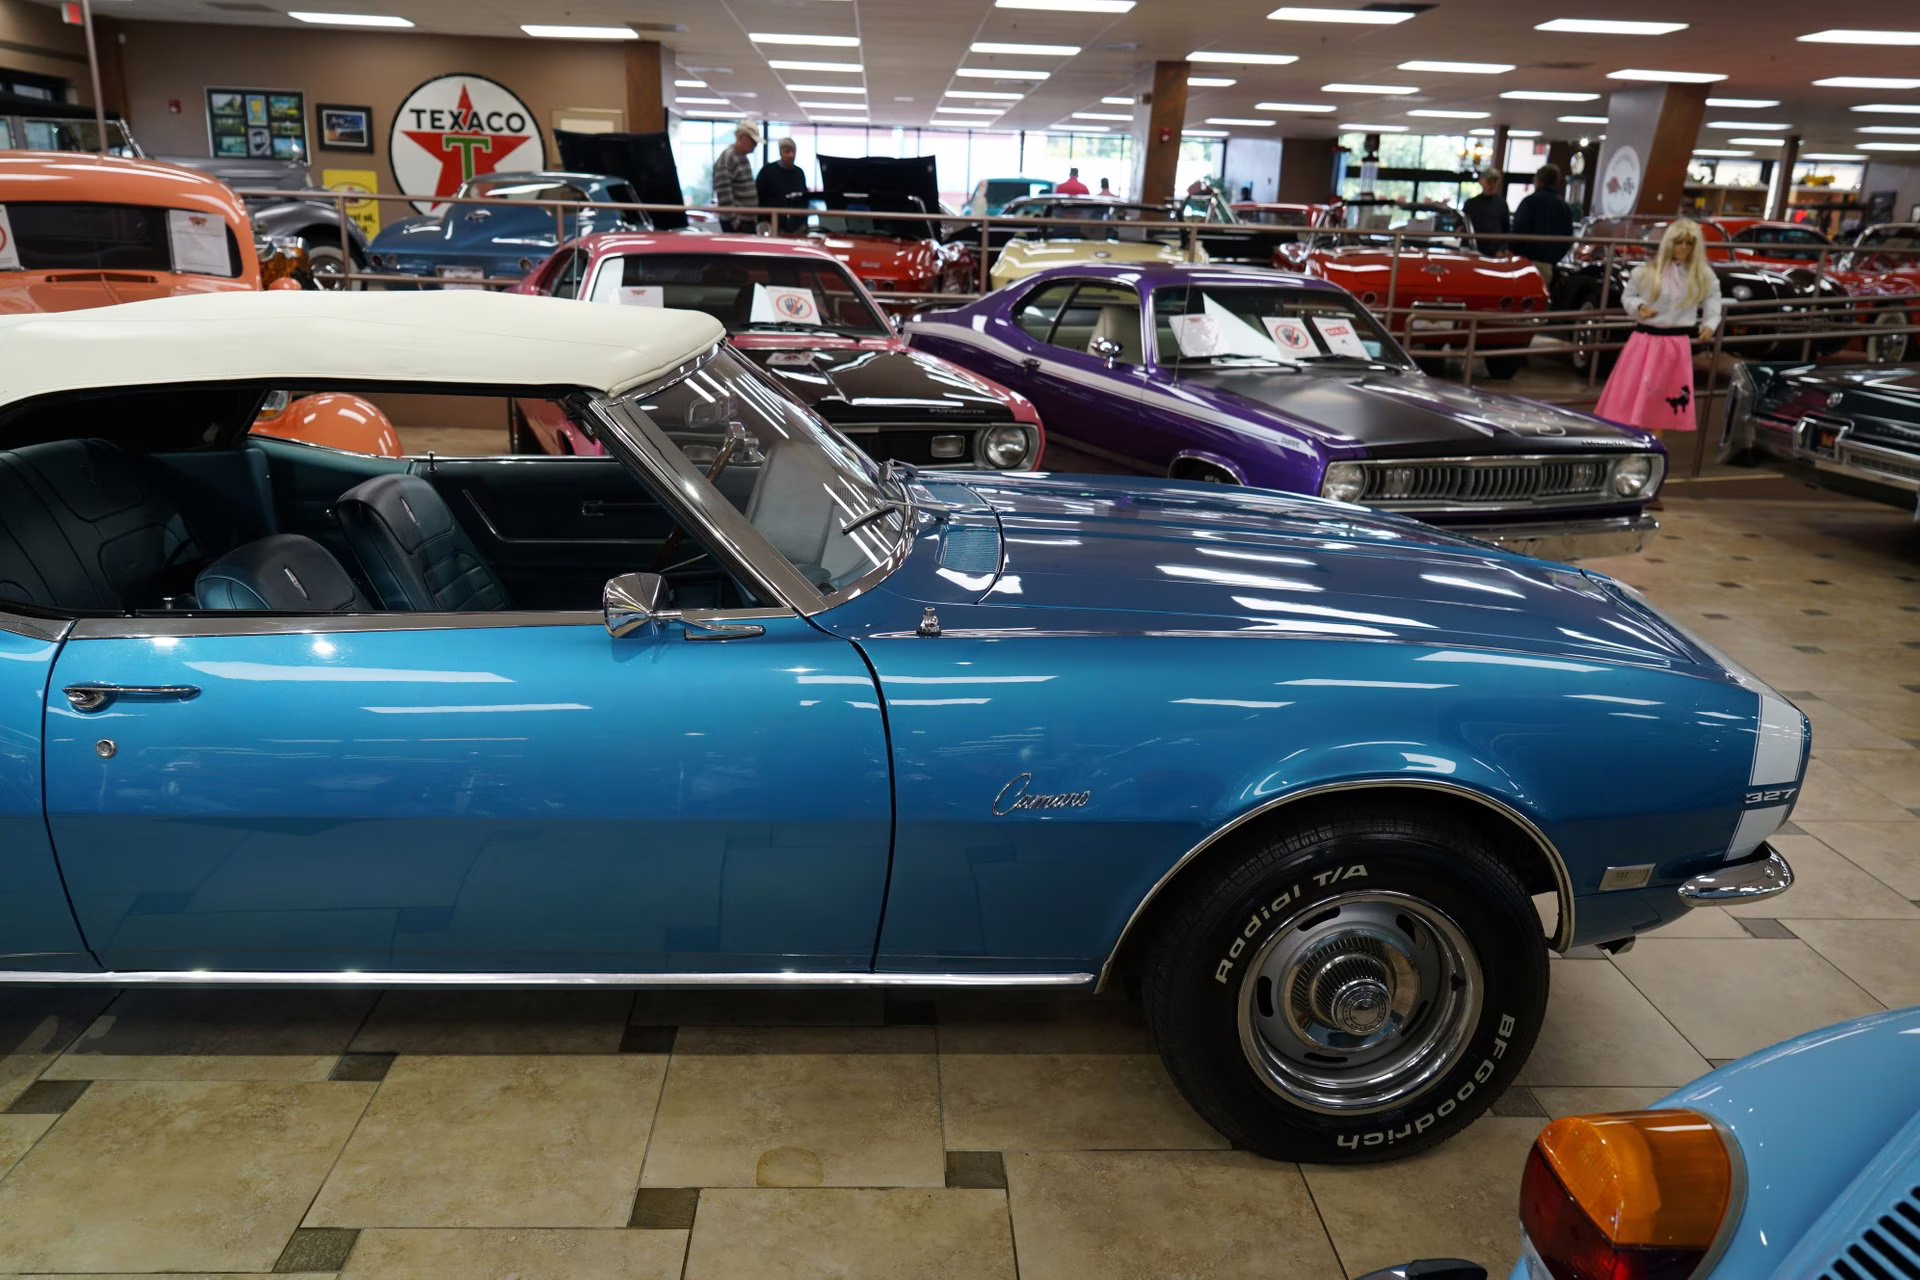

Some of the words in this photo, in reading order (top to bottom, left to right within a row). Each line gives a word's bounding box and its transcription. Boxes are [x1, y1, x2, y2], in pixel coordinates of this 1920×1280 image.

[409, 108, 526, 133] TEXACO
[443, 134, 492, 183] T
[992, 771, 1091, 816] Camaro
[1745, 787, 1797, 805] 327
[1215, 883, 1301, 985] Radial
[1312, 863, 1369, 887] T/A
[1337, 1013, 1516, 1150] BFGoodrich
